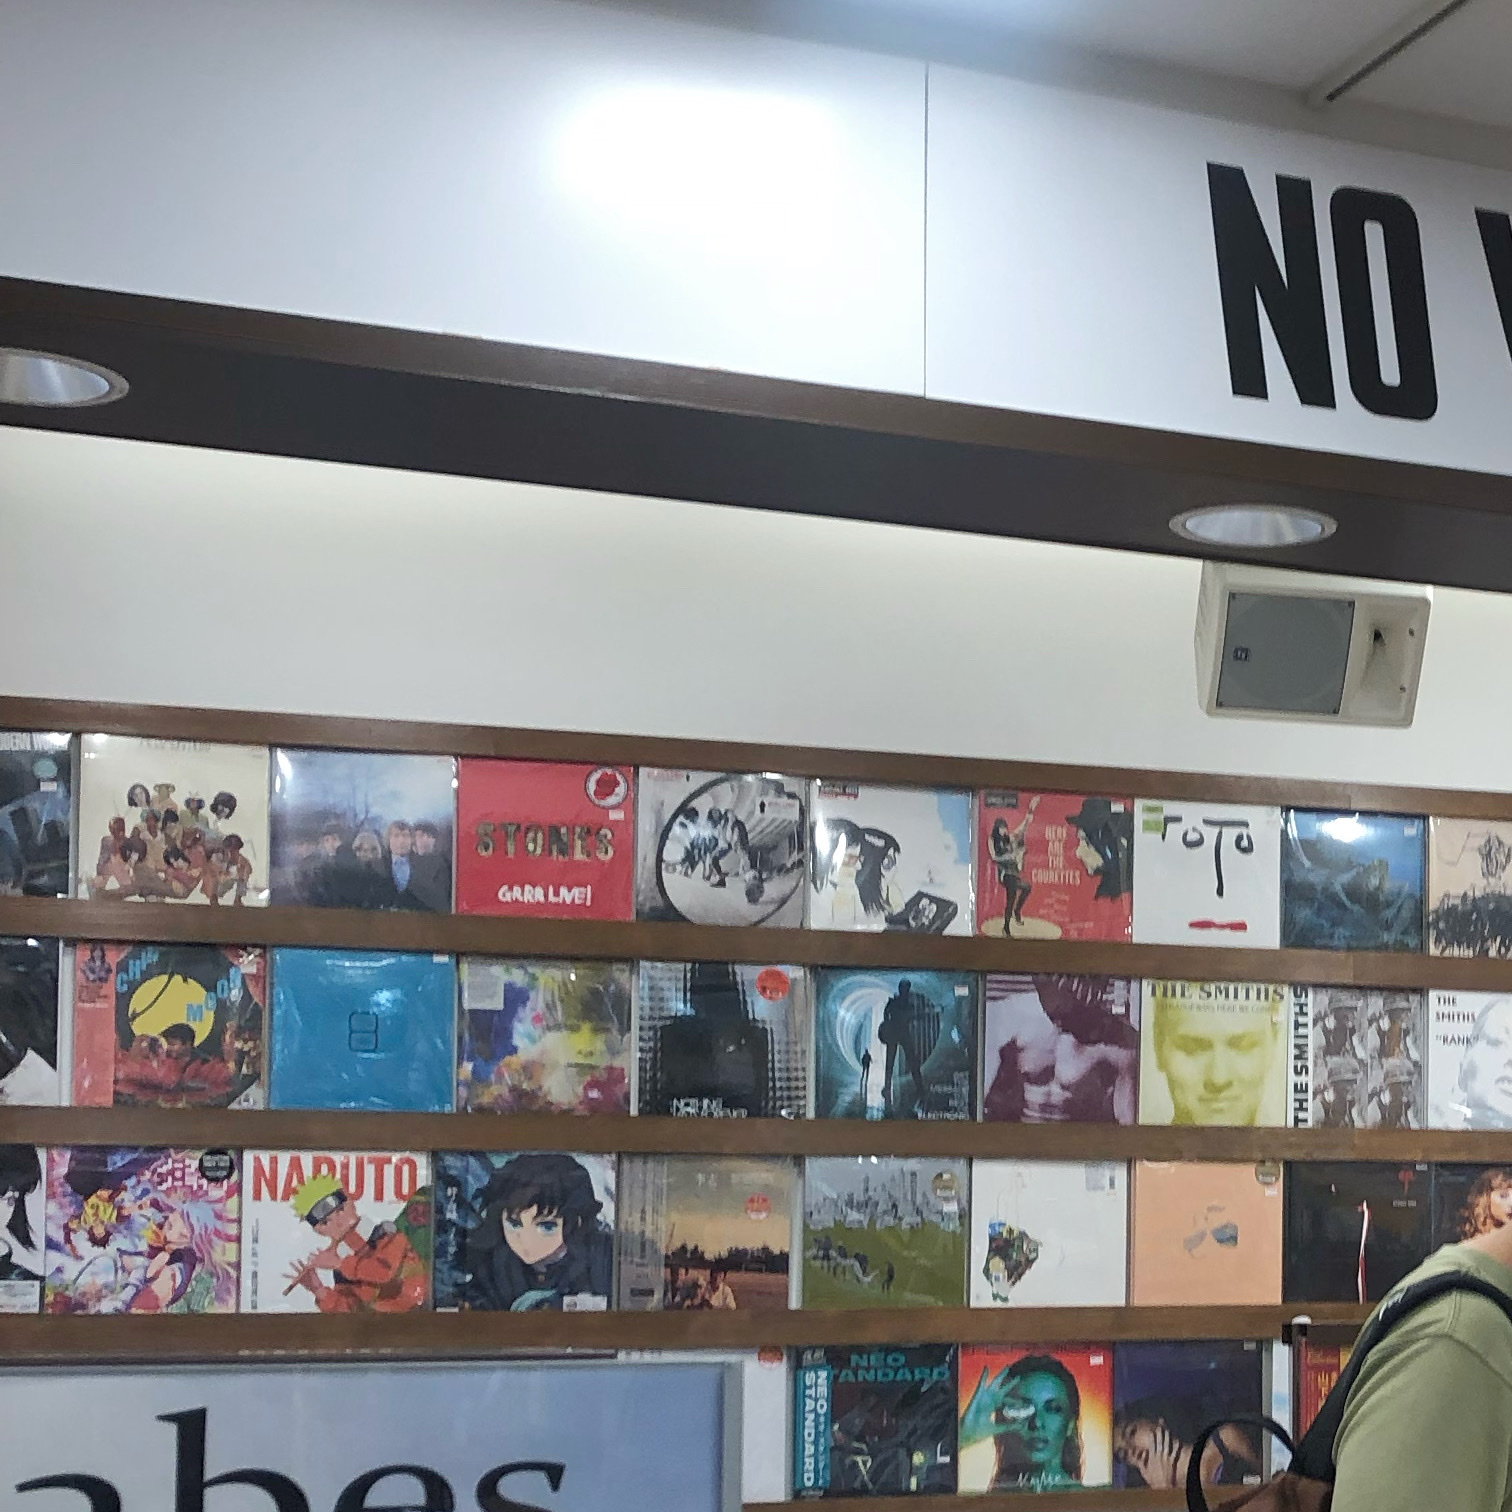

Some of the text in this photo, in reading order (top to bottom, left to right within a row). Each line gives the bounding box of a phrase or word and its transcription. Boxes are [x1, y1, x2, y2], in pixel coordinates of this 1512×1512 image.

[1206, 161, 1438, 420] NO
[476, 822, 615, 861] STONES
[1049, 857, 1064, 869] THE
[1148, 981, 1285, 1001] THE SMITHS
[1435, 996, 1457, 1007] THE
[1435, 1011, 1476, 1023] SMITHS
[1293, 986, 1309, 1127] THE SMITHS
[850, 1353, 906, 1368] NEO
[816, 1370, 828, 1415] NEO
[804, 1370, 816, 1488] STANDARD
